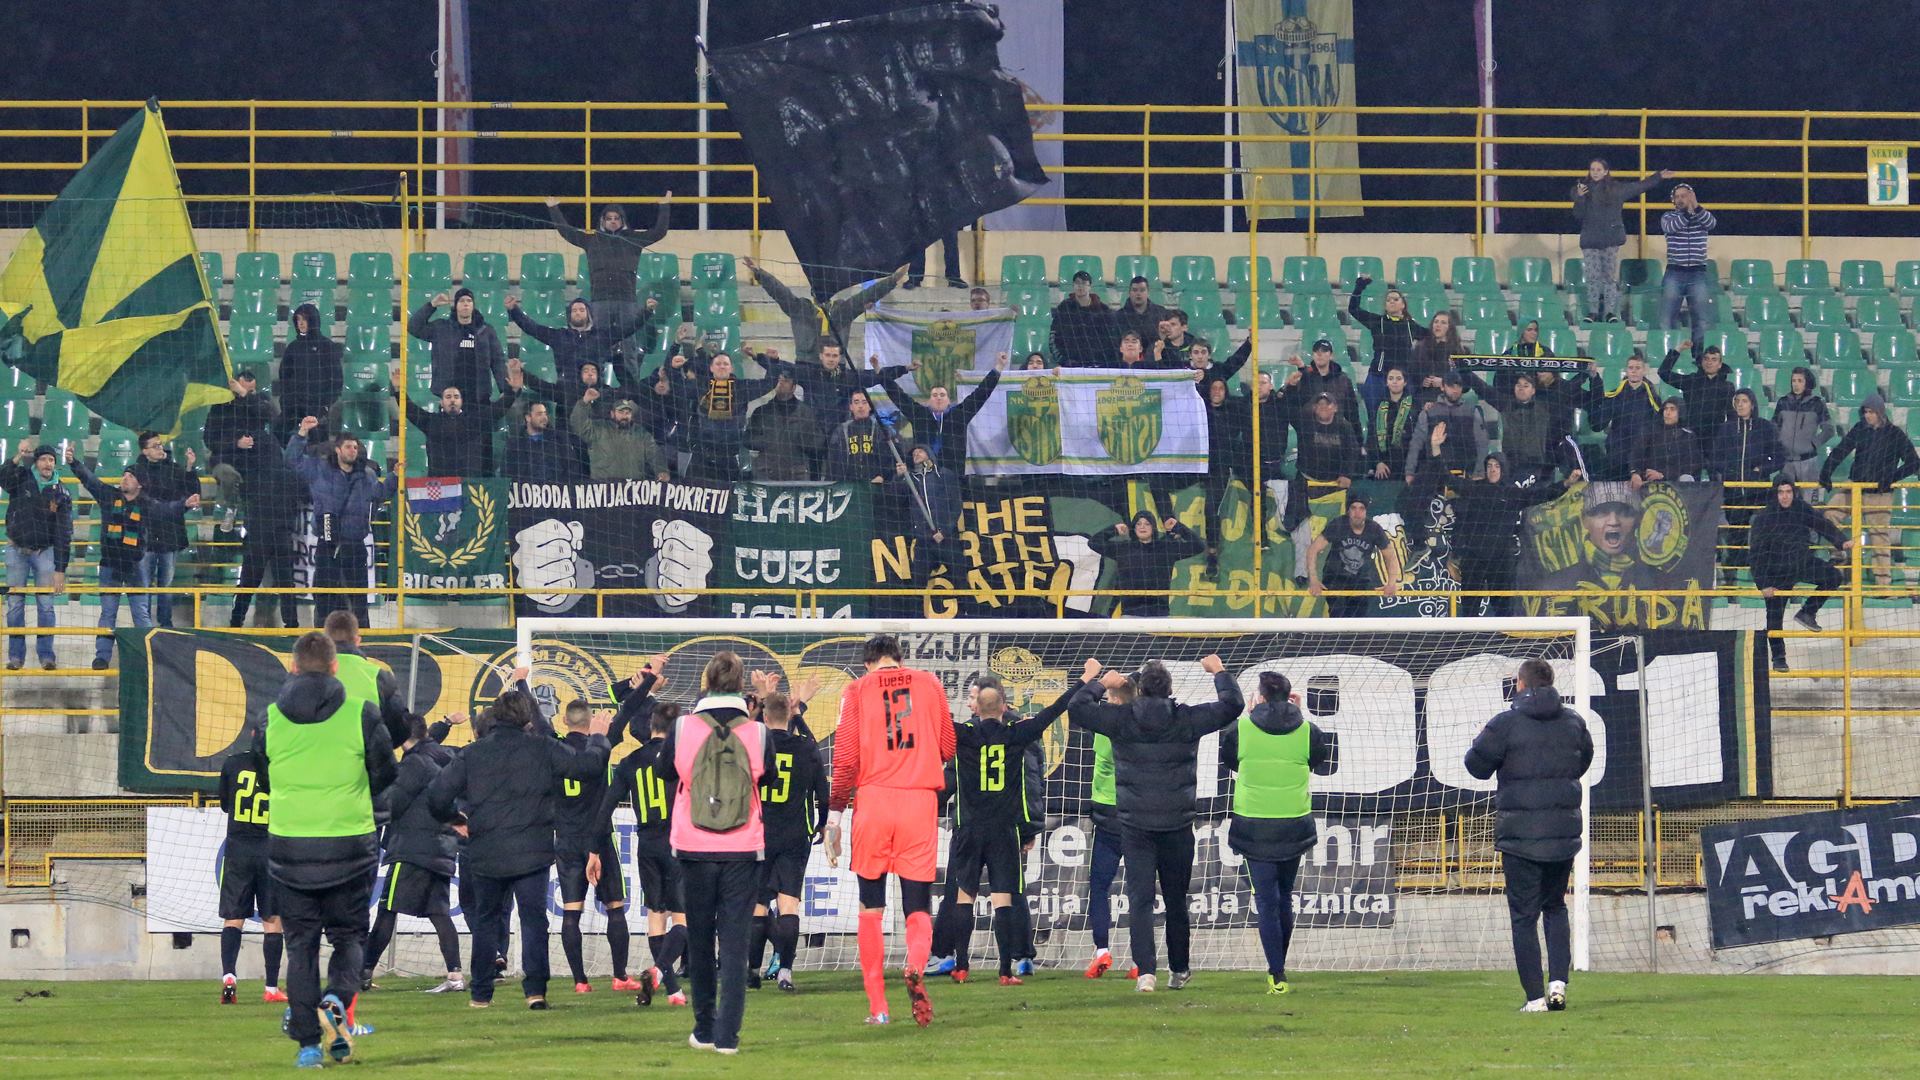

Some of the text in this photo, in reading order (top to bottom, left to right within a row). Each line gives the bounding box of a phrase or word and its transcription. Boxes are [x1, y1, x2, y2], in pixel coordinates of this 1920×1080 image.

[1463, 358, 1578, 369] VERUDA
[575, 479, 662, 510] NAVIJAČKOM
[664, 484, 730, 515] POKRETU
[733, 486, 853, 523] HARD
[735, 546, 841, 584] CORE
[882, 687, 915, 751] 12
[979, 744, 1006, 793] 13
[635, 765, 669, 824] 14
